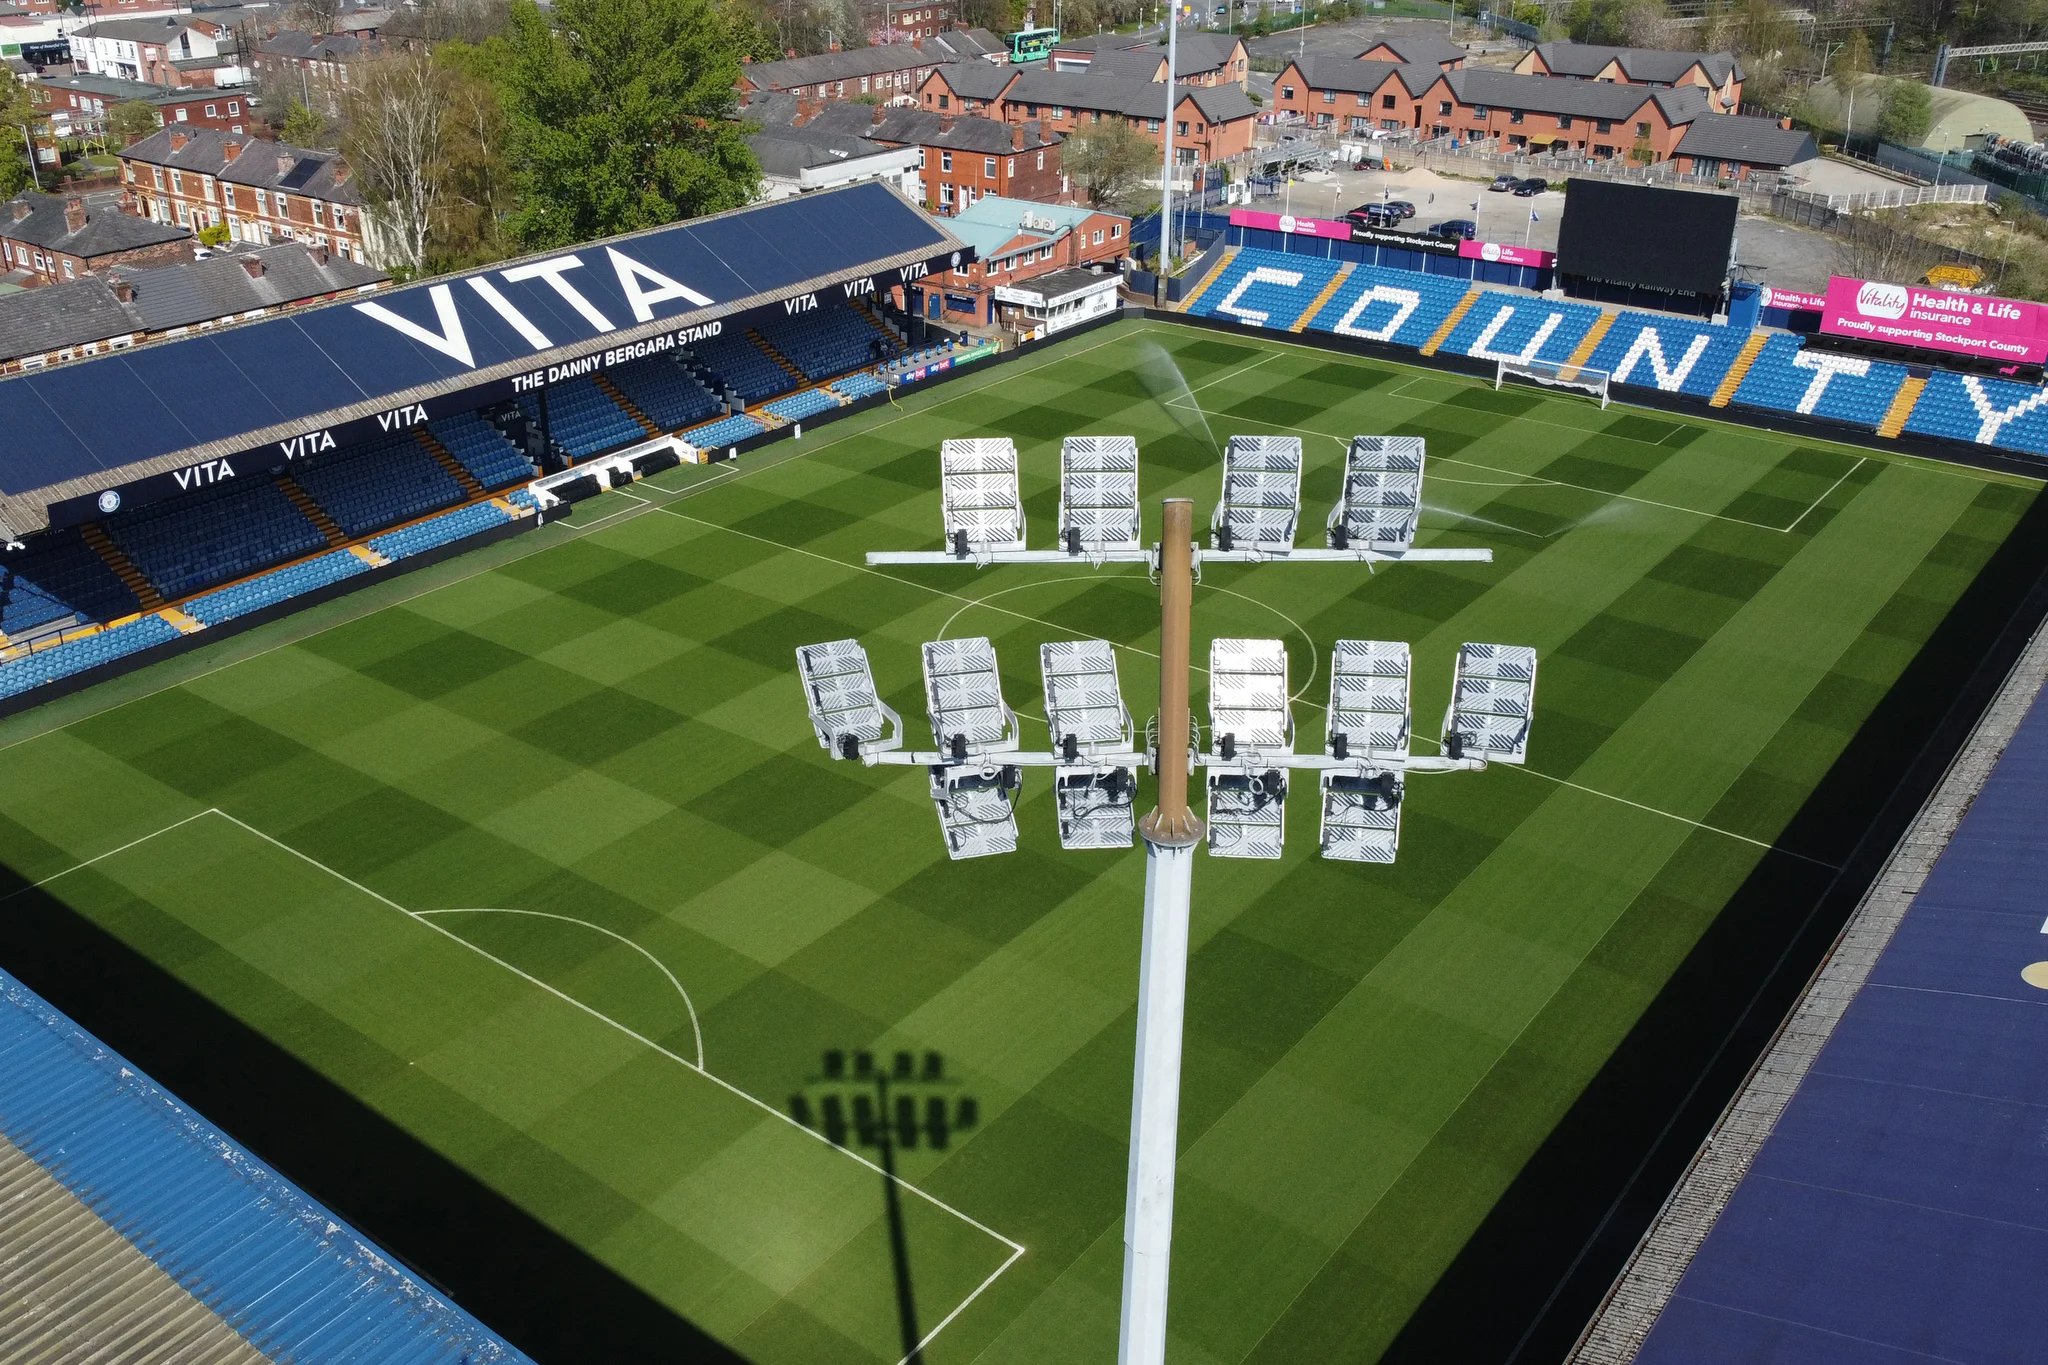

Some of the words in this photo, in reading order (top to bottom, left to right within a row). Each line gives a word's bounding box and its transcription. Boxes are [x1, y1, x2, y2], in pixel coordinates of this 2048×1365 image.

[1297, 220, 1315, 228] Health
[1352, 229, 1374, 240] Proudly
[1374, 232, 1405, 244] supporting
[1406, 236, 1434, 247] Stockport
[1435, 241, 1456, 251] County
[1502, 248, 1514, 256] Life
[900, 261, 929, 283] VITA
[844, 277, 875, 299] VITA
[1774, 292, 1800, 302] Health
[1810, 298, 1826, 306] Life
[351, 246, 715, 369] VITA
[784, 293, 818, 316] VITA
[1093, 302, 1108, 313] ODIN
[1860, 287, 1907, 315] Vitality
[1912, 292, 1969, 313] Health
[1971, 302, 1984, 316] &
[1987, 303, 2022, 320] Life
[1910, 307, 1972, 326] insurance
[1837, 318, 1876, 334] Proudly
[1877, 325, 1934, 342] supporting
[1935, 331, 1987, 348] Stockport
[1988, 340, 2029, 356] County
[511, 371, 545, 393] THE
[548, 354, 603, 383] DANNY
[604, 334, 674, 367] BERGARA
[678, 320, 722, 346] STAND
[930, 364, 940, 373] sky
[939, 360, 949, 369] bet
[906, 372, 915, 381] sky
[915, 368, 925, 377] bet
[377, 403, 429, 432] VITA
[501, 410, 521, 422] VITA
[280, 430, 337, 460] VITA
[173, 458, 236, 490] VITA
